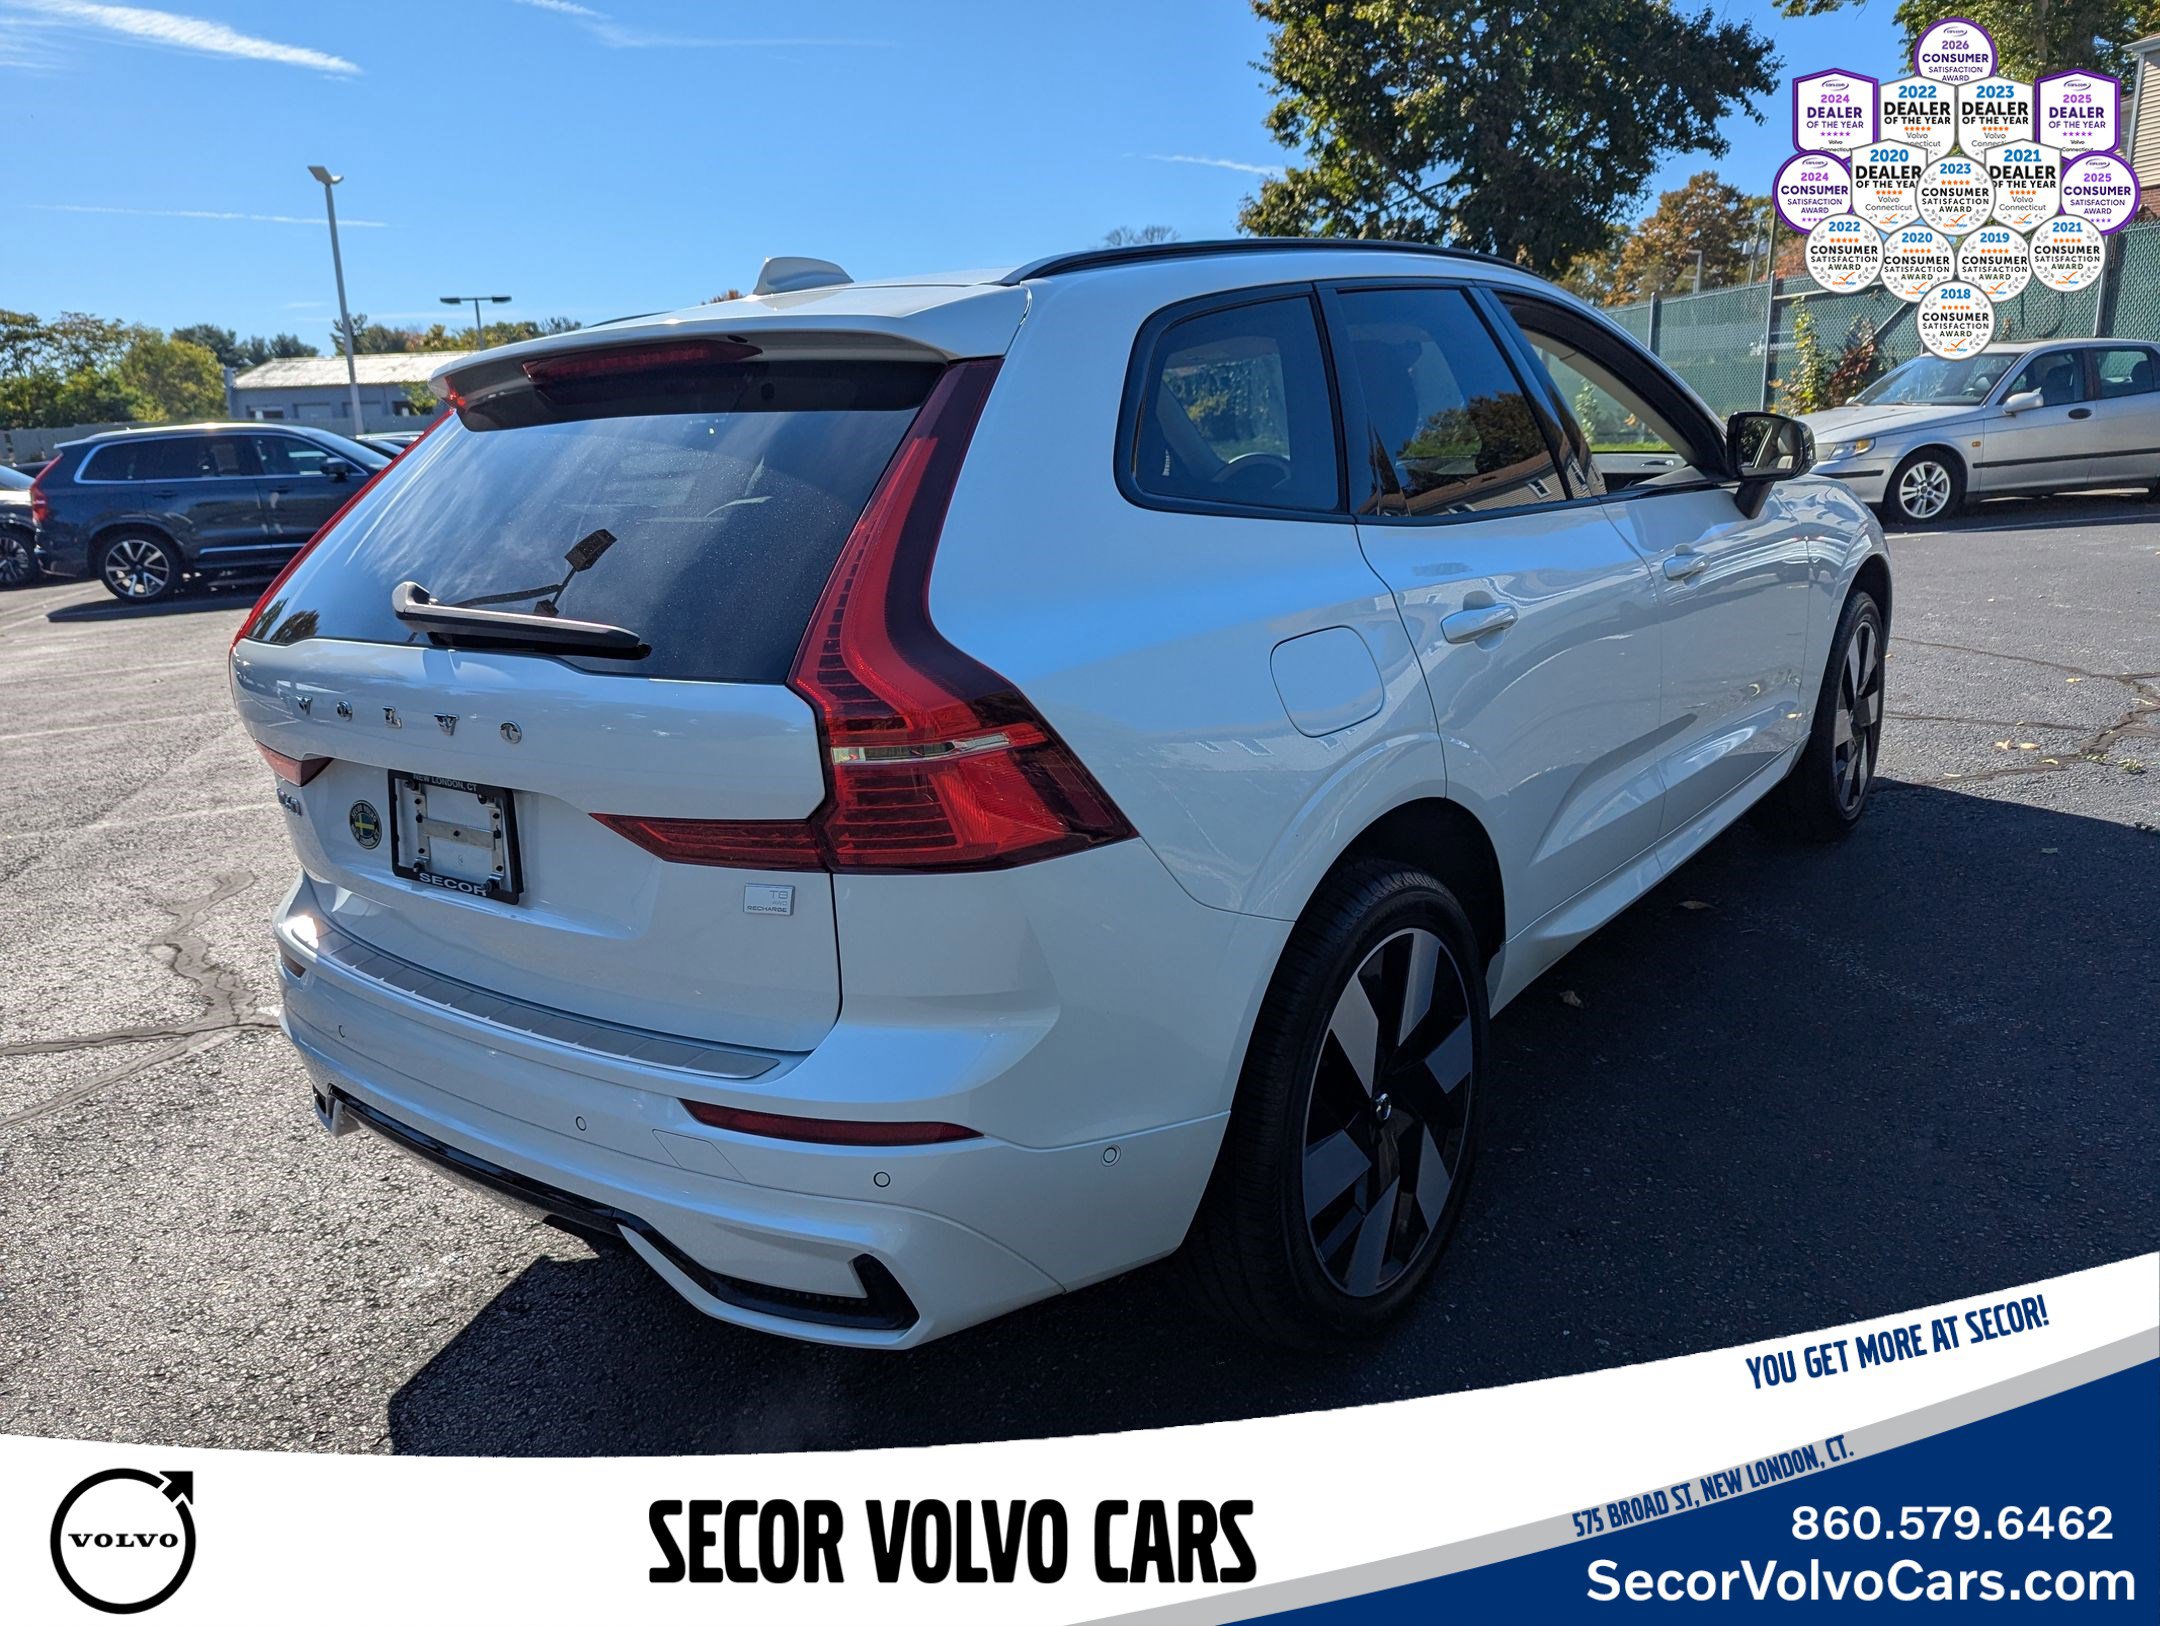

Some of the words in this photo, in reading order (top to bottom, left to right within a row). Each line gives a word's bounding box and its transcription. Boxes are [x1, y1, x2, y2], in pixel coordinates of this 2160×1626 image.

[295, 695, 523, 744] VOLVO
[467, 783, 477, 792] CT
[419, 873, 487, 896] SECOR
